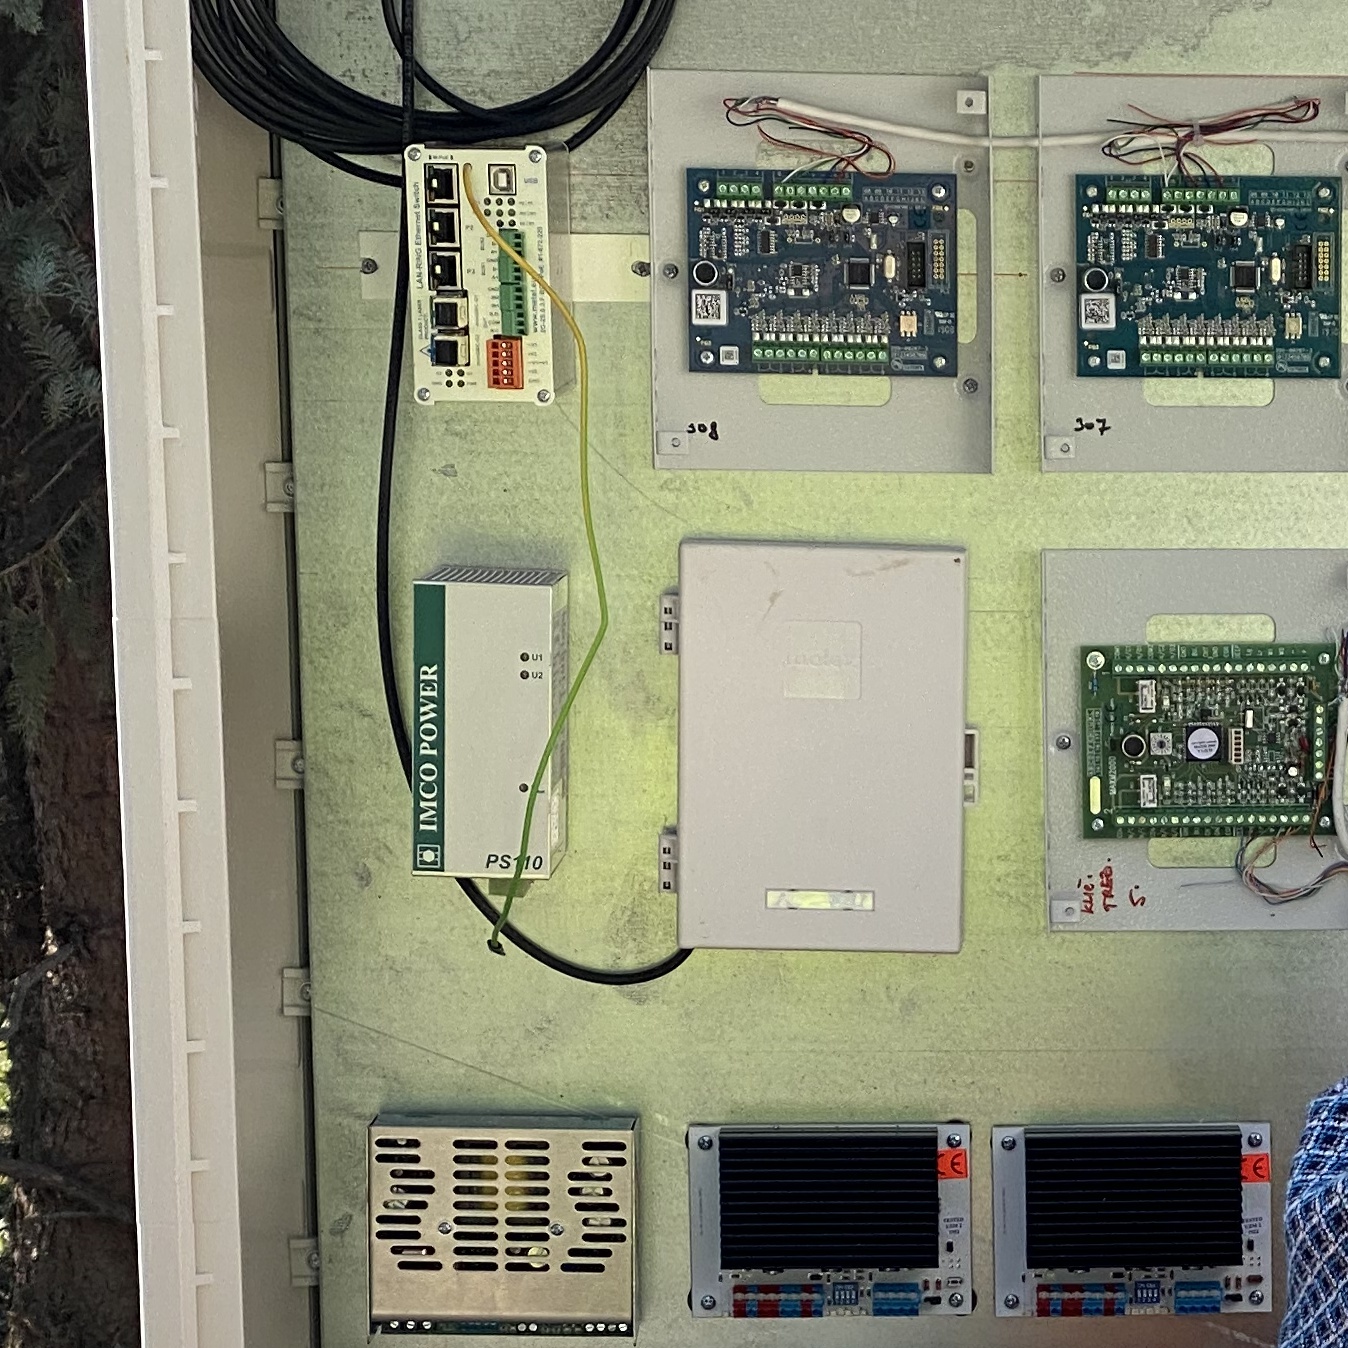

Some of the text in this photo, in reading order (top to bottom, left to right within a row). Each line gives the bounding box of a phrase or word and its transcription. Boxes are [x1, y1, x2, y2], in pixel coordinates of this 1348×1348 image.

[412, 182, 424, 289] LAN-RING Ethernet Switch
[531, 653, 543, 662] U1
[531, 671, 544, 680] U2
[418, 663, 439, 833] IMCO POWER
